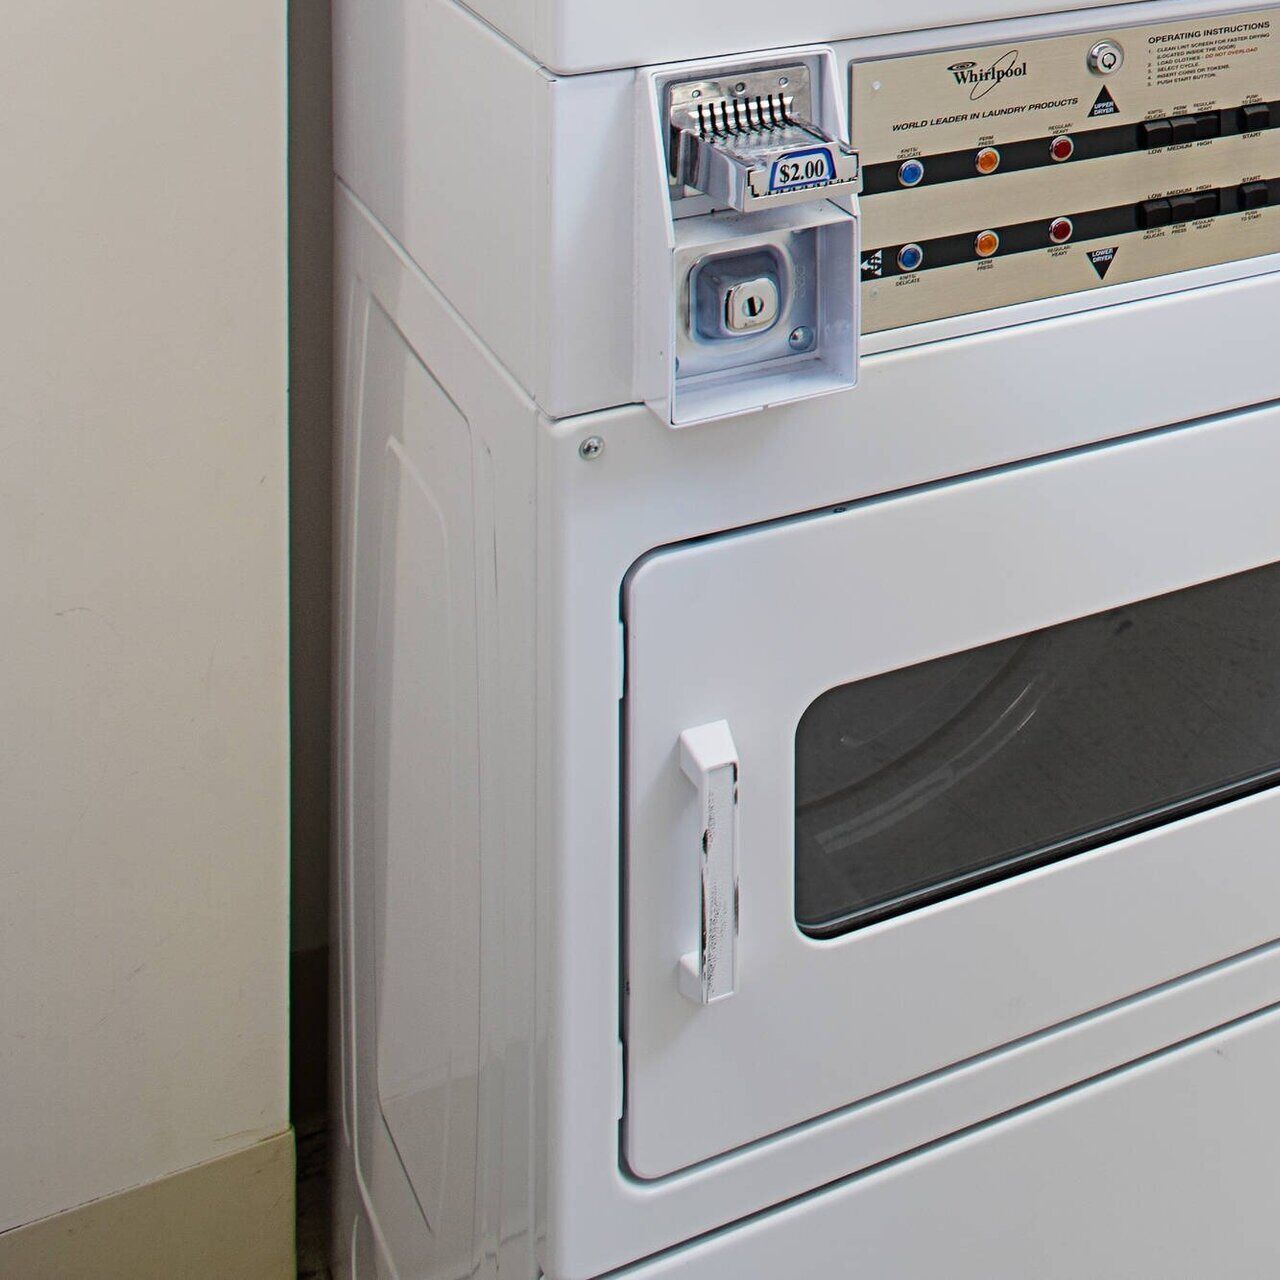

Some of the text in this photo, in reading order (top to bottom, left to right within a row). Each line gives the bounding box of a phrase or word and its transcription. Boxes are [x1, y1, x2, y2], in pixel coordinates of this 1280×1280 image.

[1148, 21, 1270, 44] OPERATING INSTRUCTIONS
[1157, 45, 1176, 53] CLEAN
[1177, 43, 1190, 51] LINT
[1191, 40, 1214, 49] SCREEN
[1214, 38, 1226, 46] FOR
[1227, 35, 1248, 44] FASTER
[1249, 32, 1270, 41] DRYING
[1157, 59, 1174, 67] LOAD
[1174, 55, 1200, 64] CLOTHES
[1227, 47, 1258, 56] OVERLOAD
[953, 62, 1027, 85] Whirlpool
[1157, 64, 1180, 73] SELECT
[1157, 71, 1177, 79] INSERT
[1157, 78, 1173, 87] PUSH
[1174, 75, 1192, 83] START
[1093, 101, 1114, 110] UPPER
[1093, 107, 1115, 116] DRYER
[892, 97, 1079, 132] WORLD LEADER IN LAUNDRY PRODUCTS
[1242, 131, 1262, 140] START
[1148, 140, 1213, 156] LOW MEDIUM HIGH
[780, 159, 825, 184] $2.00
[1242, 175, 1262, 183] START
[1147, 183, 1213, 200] LOW MEDIUM HIGH
[1091, 248, 1114, 258] LOWER
[1092, 253, 1113, 264] DRYER
